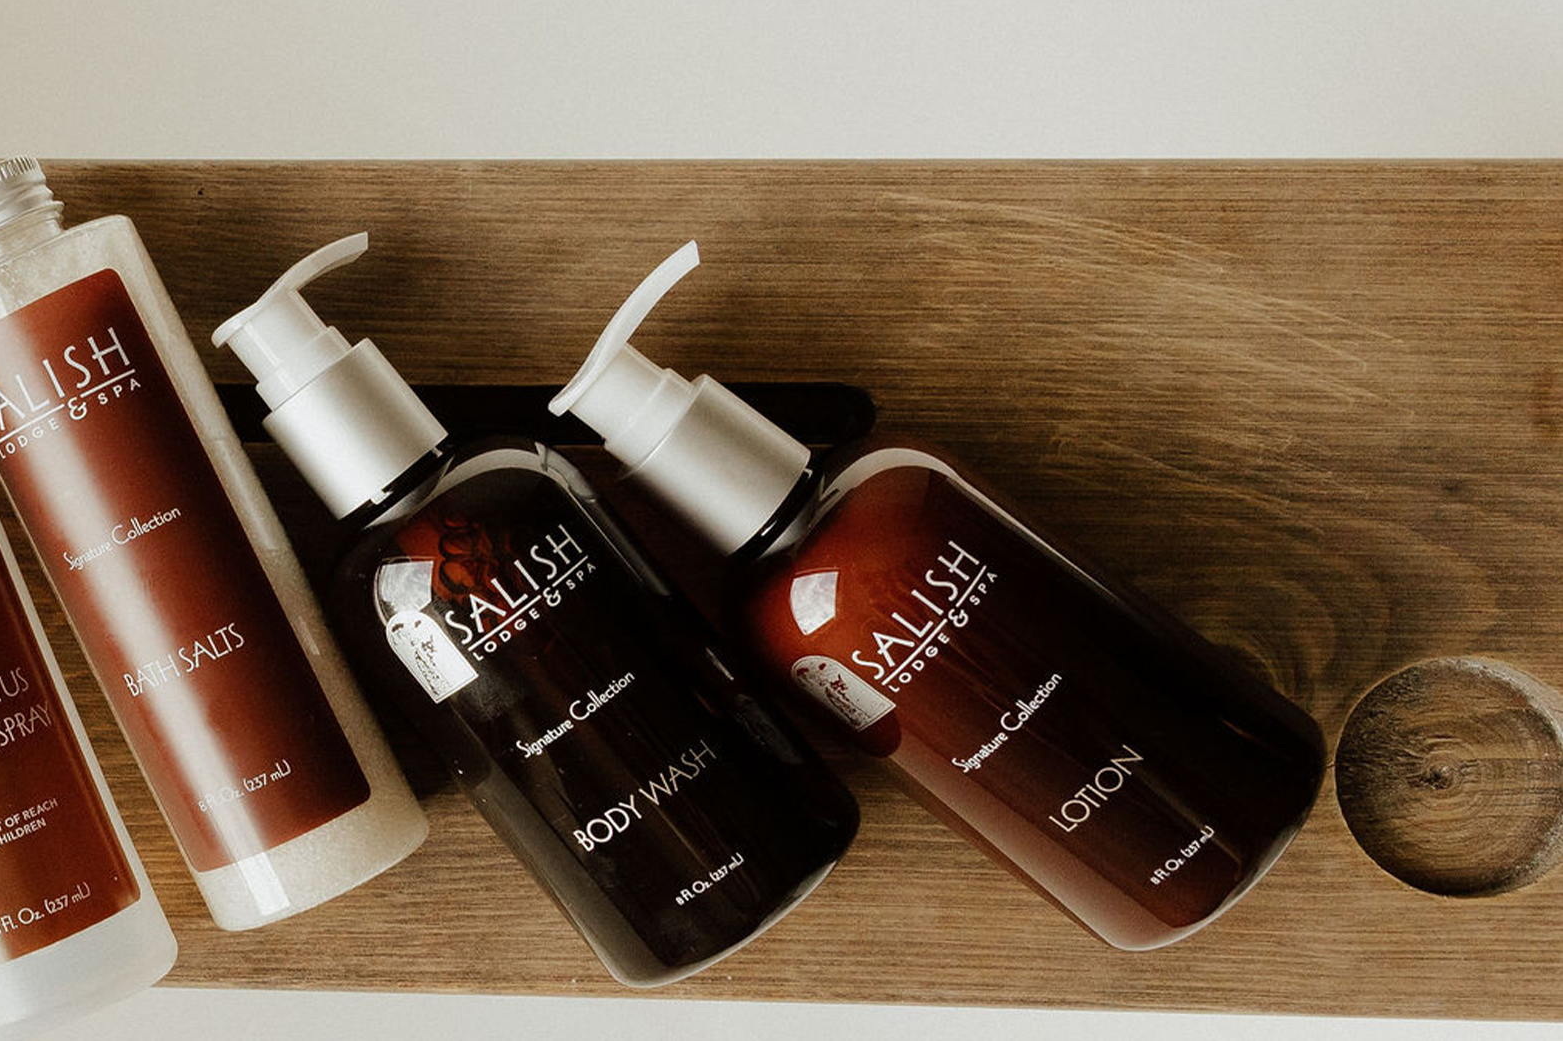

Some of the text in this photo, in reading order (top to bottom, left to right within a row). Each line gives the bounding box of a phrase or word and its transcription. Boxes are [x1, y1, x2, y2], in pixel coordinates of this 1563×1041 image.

[67, 396, 88, 421] &
[97, 377, 141, 405] SPA
[63, 507, 182, 570] Signature Collection
[444, 524, 583, 645] SALISH
[473, 562, 596, 661] LODGE & SPA
[851, 540, 980, 680] SALISH
[123, 622, 245, 697] BATH SALTS
[888, 572, 998, 693] LODGE & SPA
[516, 672, 635, 758] Signature Collection
[951, 673, 1063, 773] Signature Collection
[4, 813, 21, 828] OF
[22, 798, 59, 821] REACH
[198, 800, 207, 812] 8
[243, 773, 267, 792] (237
[270, 759, 291, 781] mL)
[573, 739, 716, 852] BODY WASH
[1048, 743, 1144, 833] LOTION
[675, 896, 685, 906] 8
[708, 865, 728, 882] (237
[1149, 876, 1161, 885] 8
[1179, 839, 1201, 858] (237
[18, 907, 45, 924] Oz.
[44, 894, 69, 915] (237
[71, 881, 91, 903] mL)
